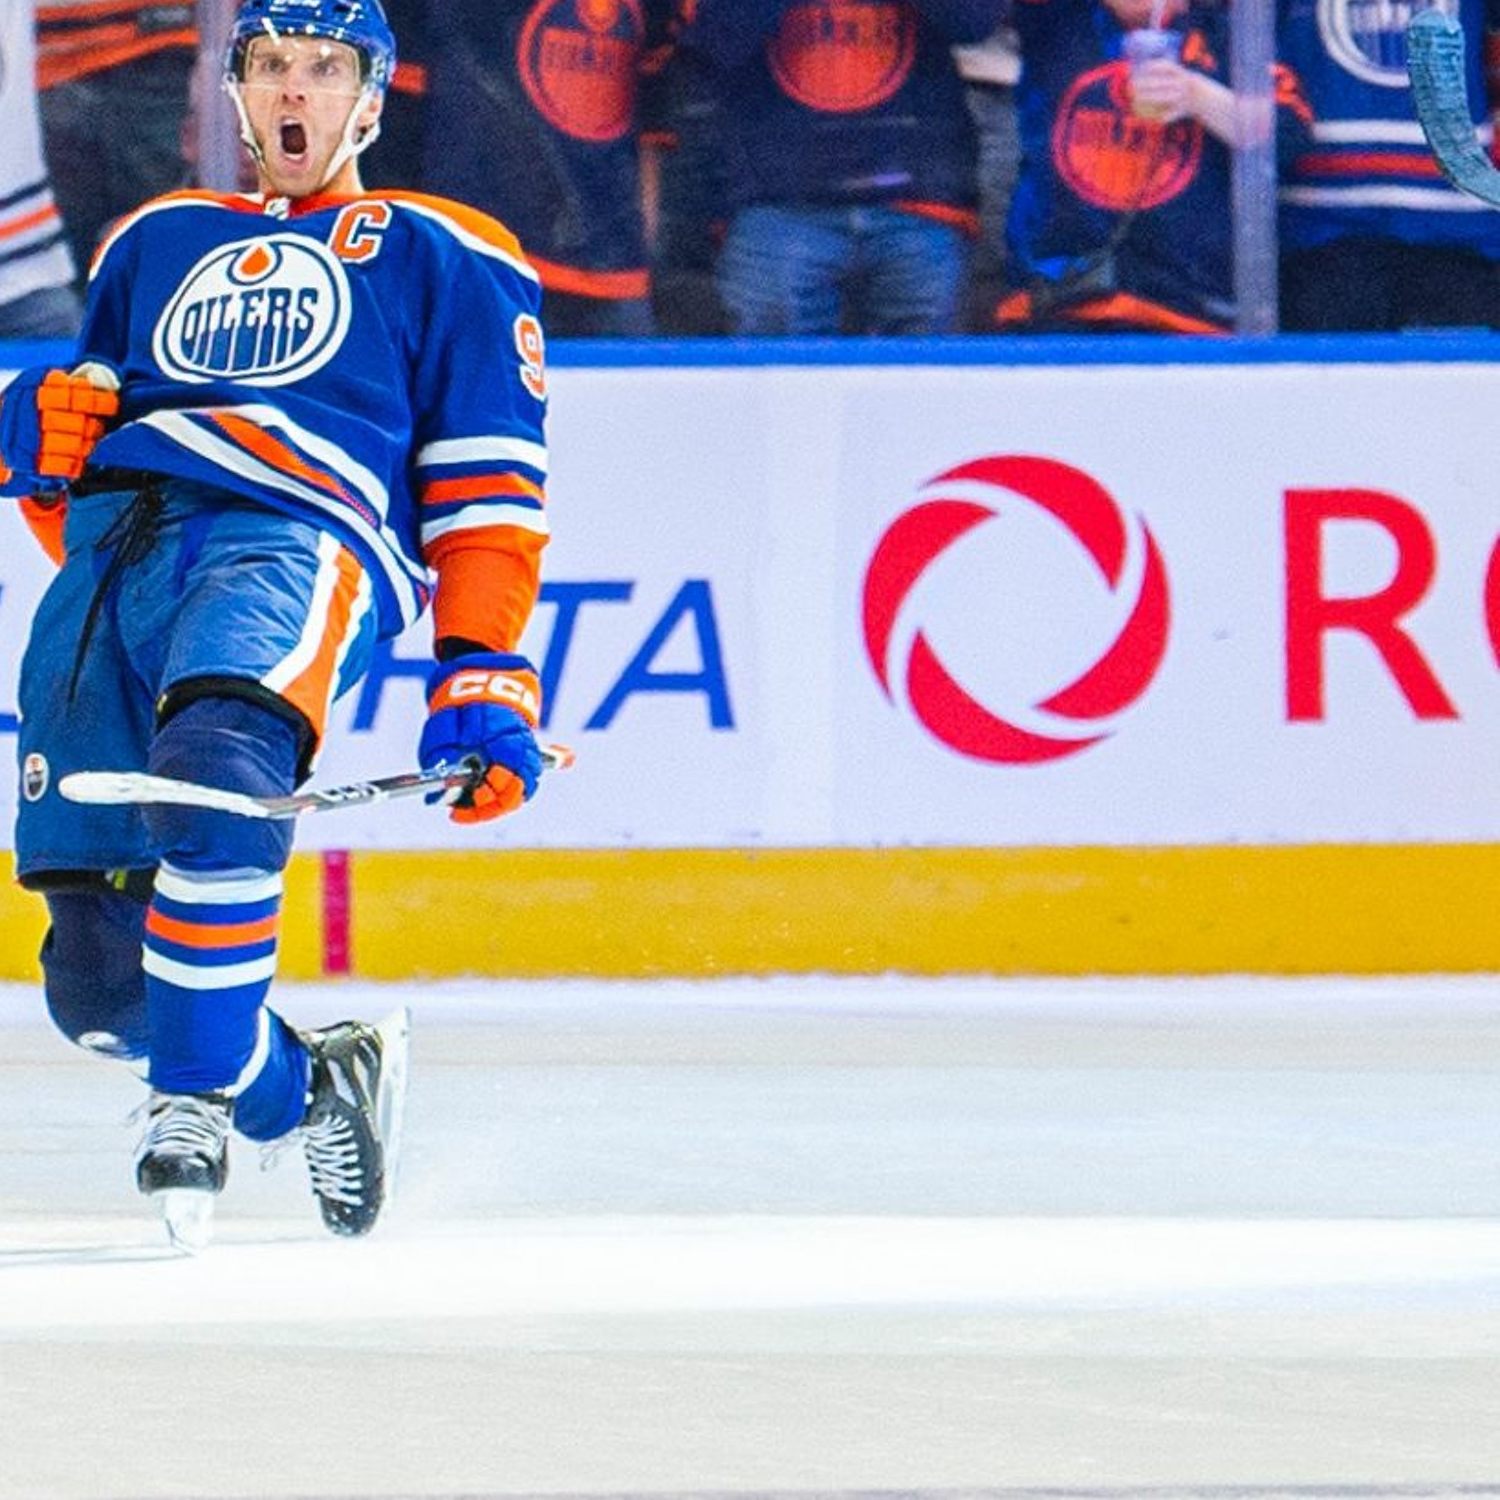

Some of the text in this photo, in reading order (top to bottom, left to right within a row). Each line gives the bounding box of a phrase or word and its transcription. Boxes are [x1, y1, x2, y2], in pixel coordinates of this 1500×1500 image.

[329, 200, 392, 264] C
[180, 287, 319, 345] OILERS
[1284, 486, 1500, 723] R
